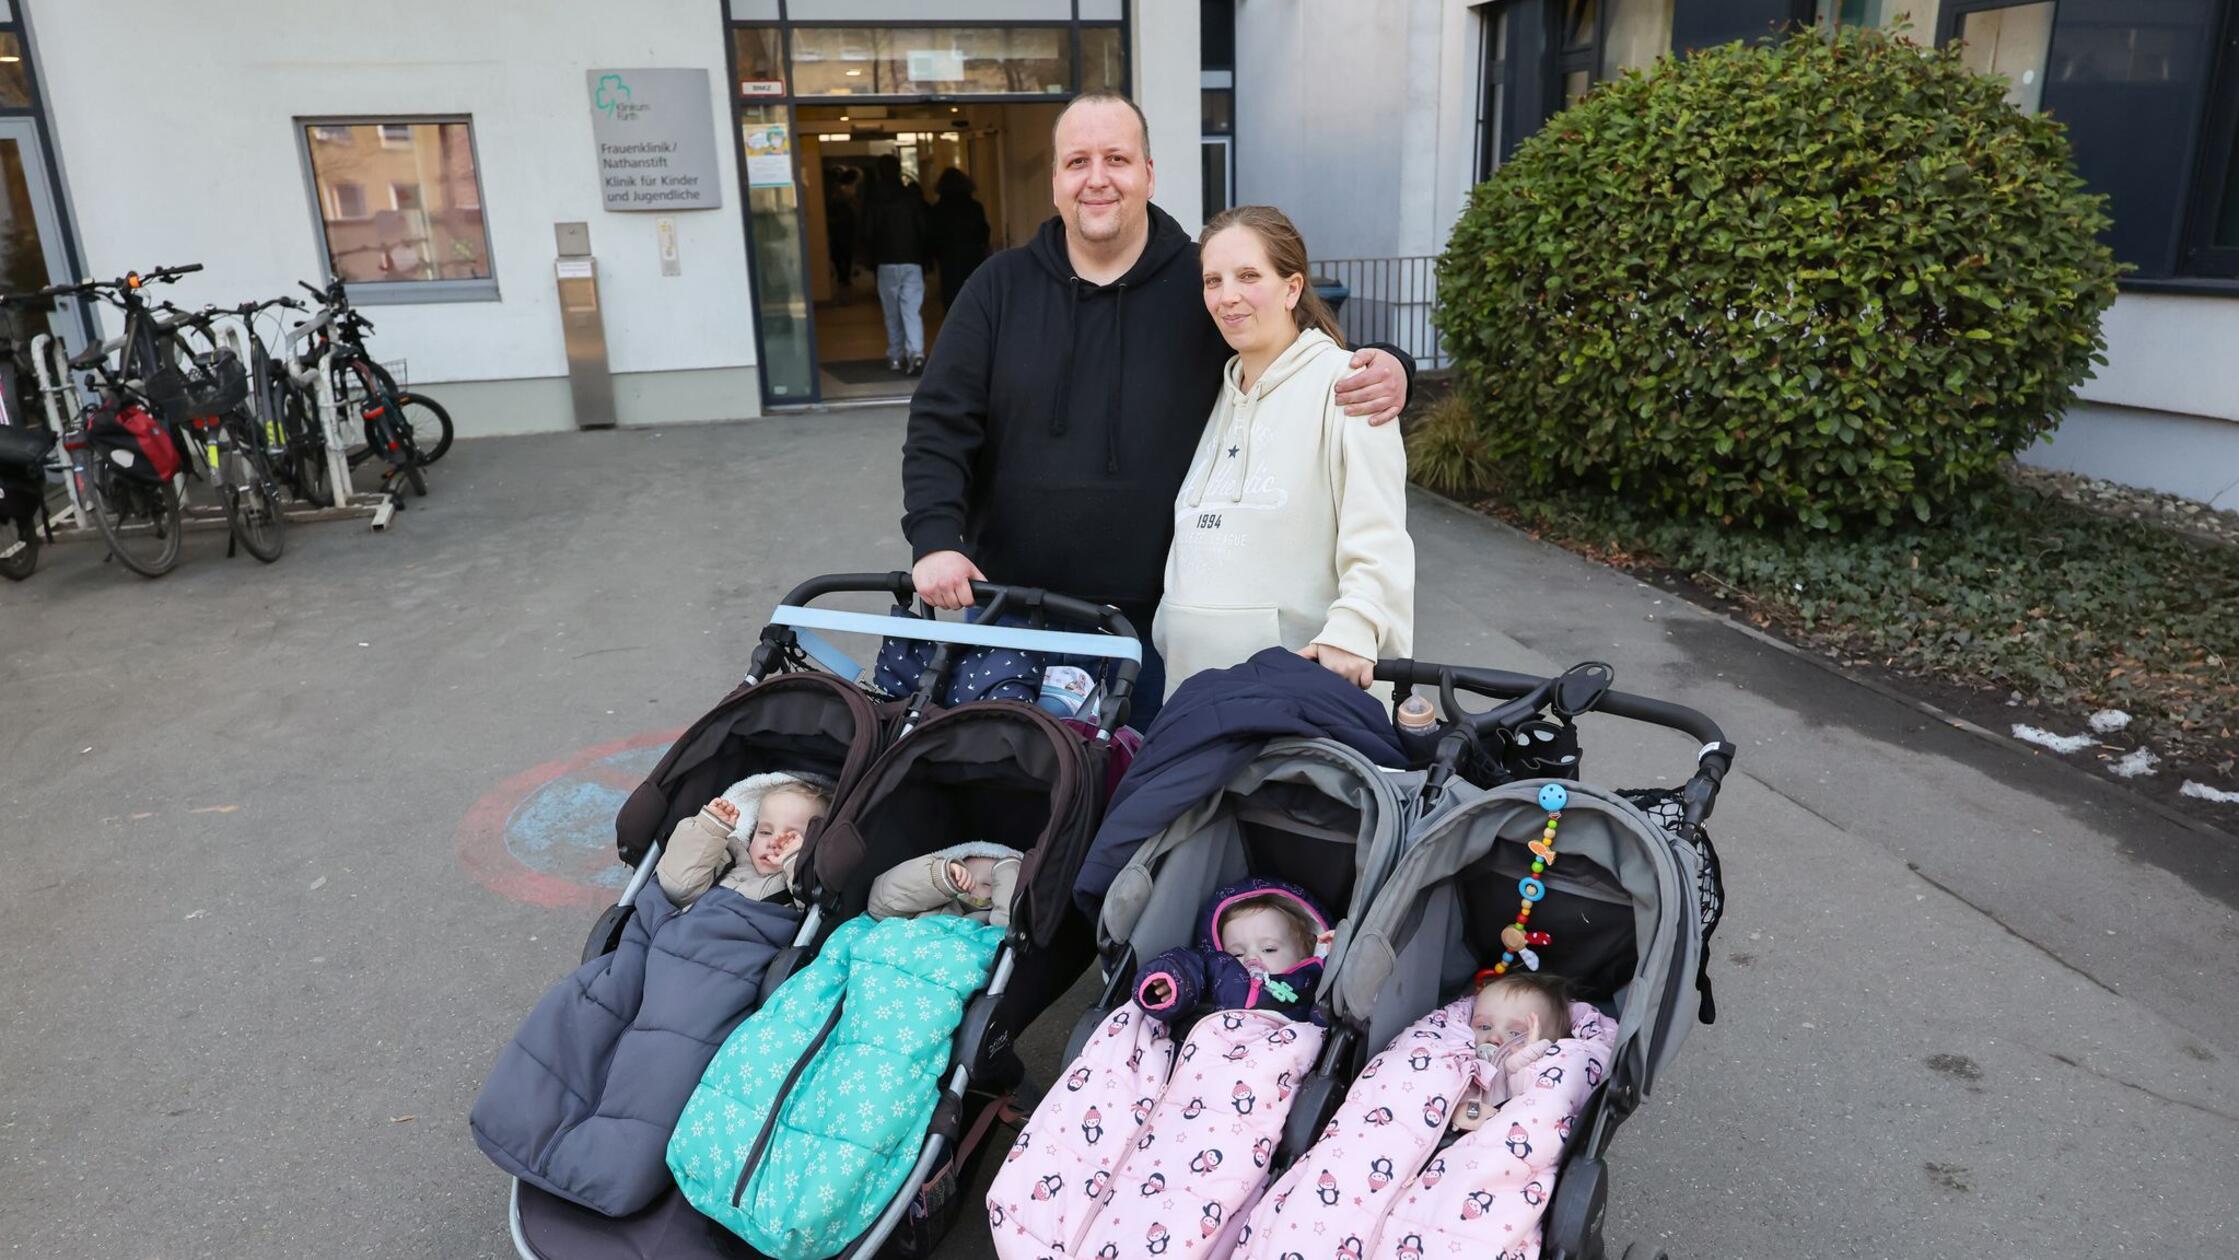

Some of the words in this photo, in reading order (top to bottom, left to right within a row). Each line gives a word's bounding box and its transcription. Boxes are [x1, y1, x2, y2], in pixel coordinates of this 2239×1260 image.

[601, 142, 678, 154] Frauenklinik/
[603, 157, 668, 169] Nathanstift
[606, 176, 636, 187] Klinik
[641, 175, 657, 186] für
[661, 174, 699, 185] Kinder
[607, 191, 629, 202] und
[633, 189, 700, 204] Jugendliche
[1196, 514, 1222, 529] 1994
